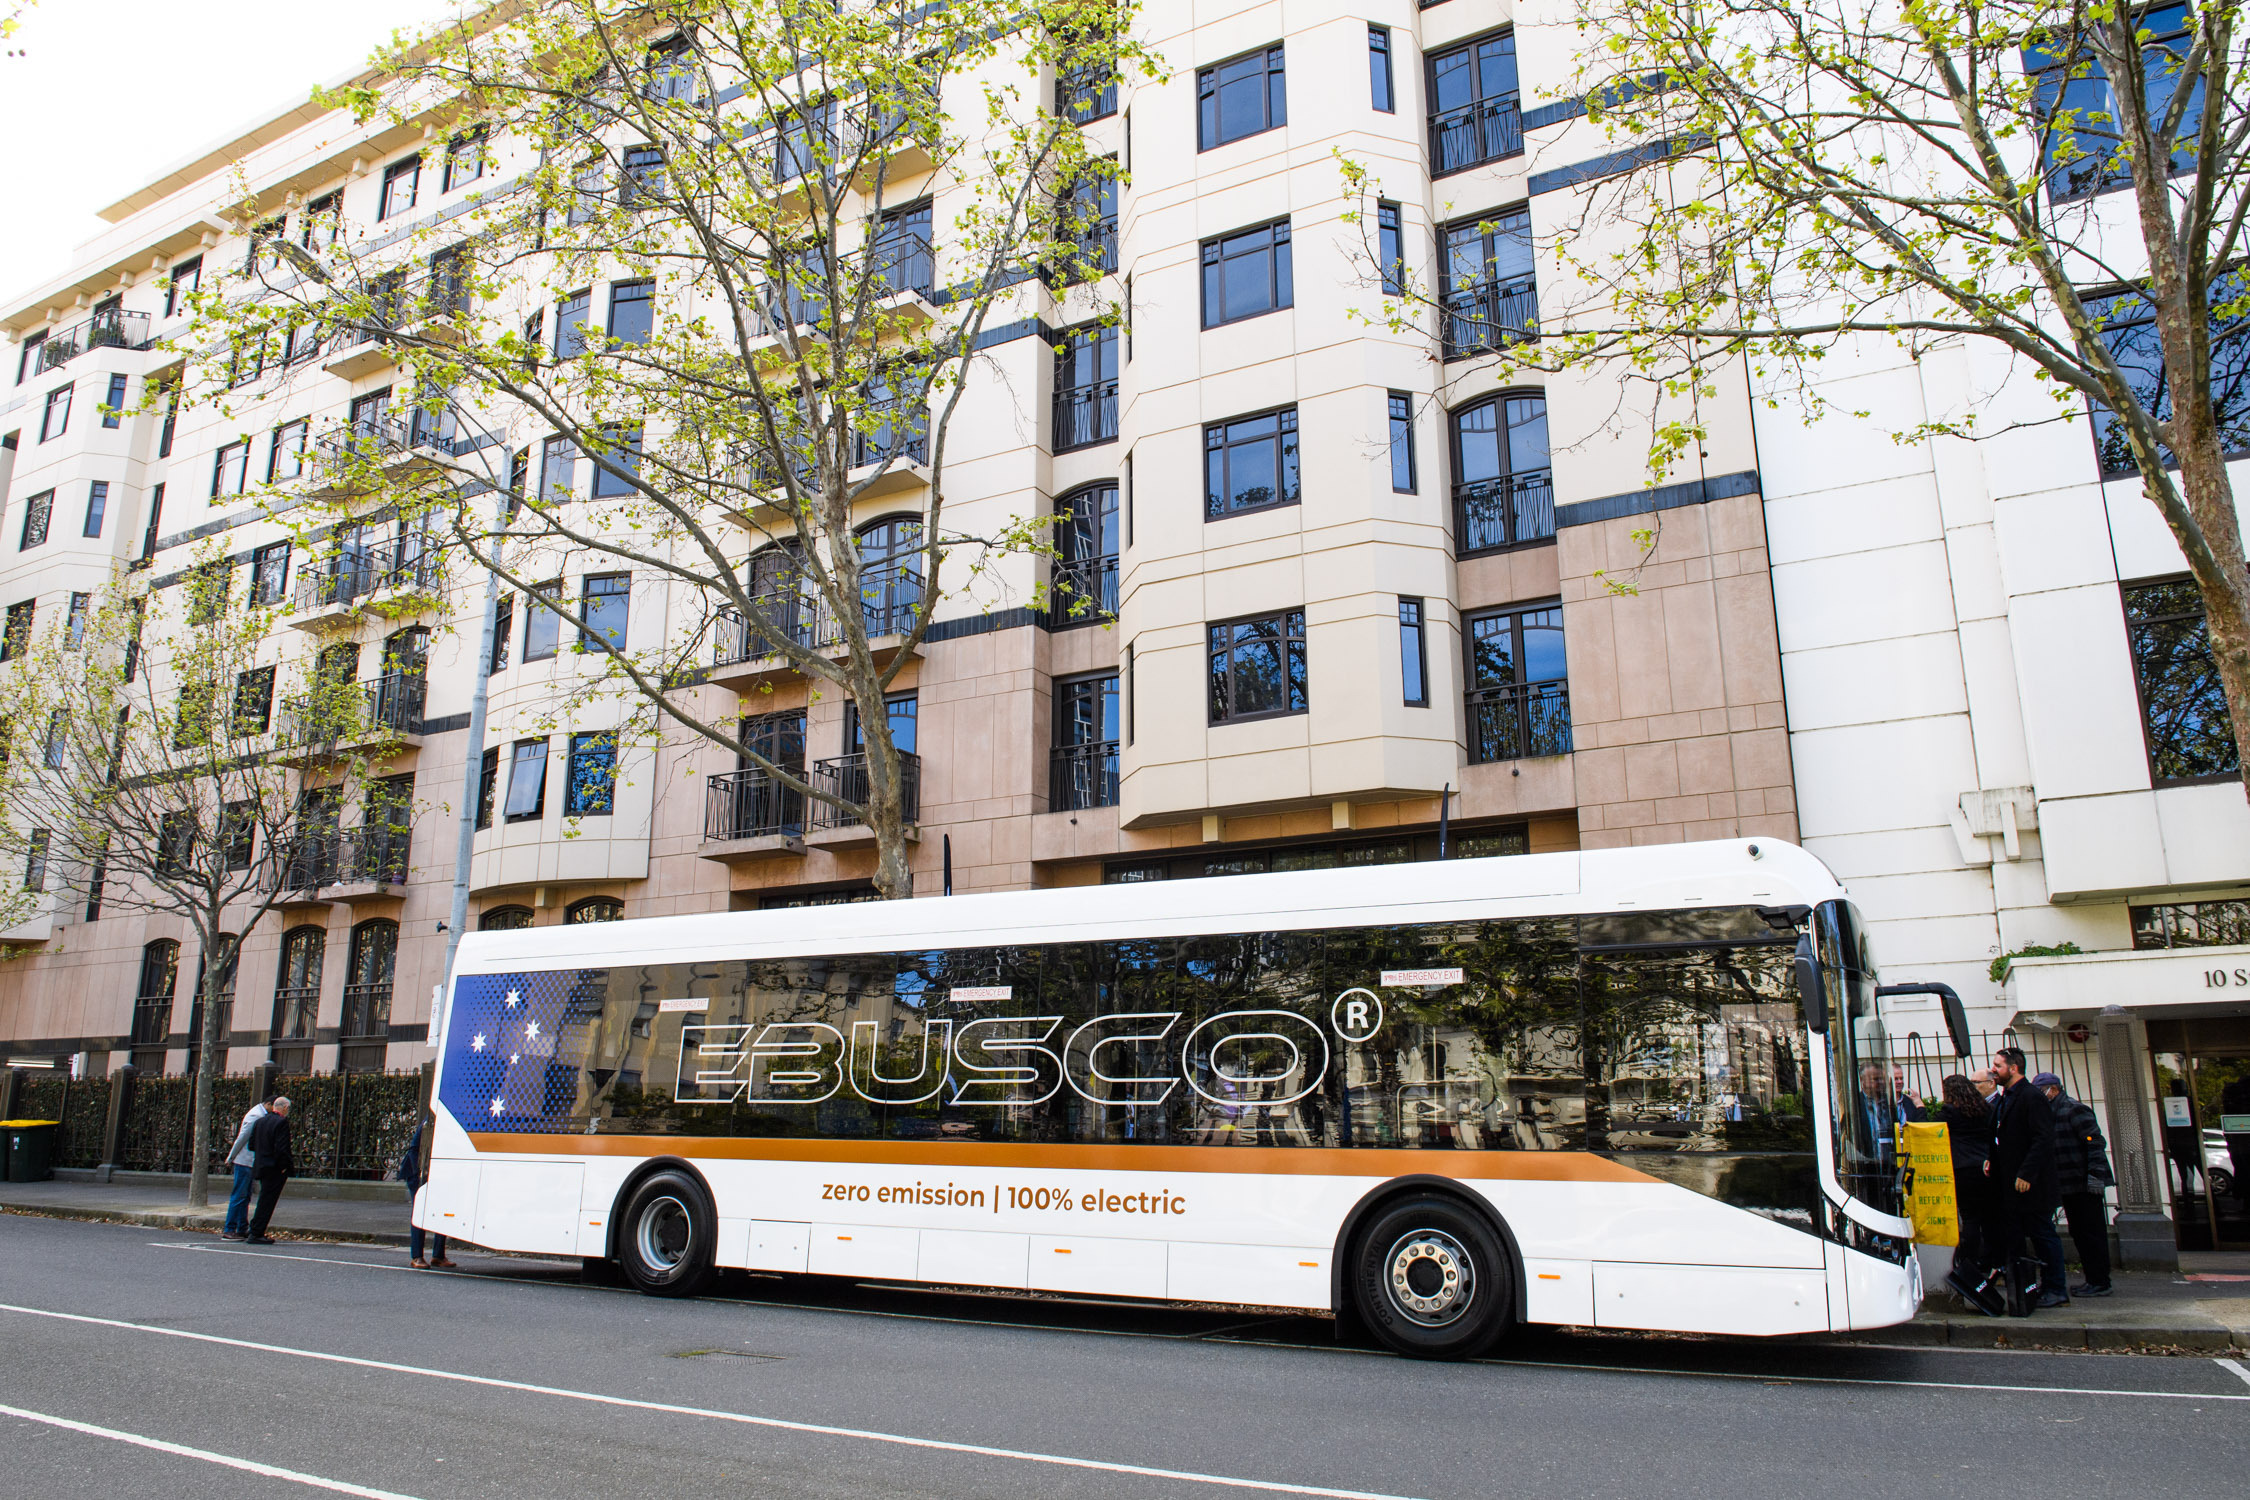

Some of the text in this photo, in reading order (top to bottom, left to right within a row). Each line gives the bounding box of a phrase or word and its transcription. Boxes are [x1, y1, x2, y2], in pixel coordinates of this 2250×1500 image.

[1398, 970, 1460, 982] EMERGENCY EXIT
[2203, 968, 2250, 988] 10 S
[963, 987, 1010, 998] EMERGENCY EXIT
[1913, 1154, 1949, 1164] RESERVED
[1918, 1175, 1949, 1184] PARKING
[821, 1183, 871, 1202] zero
[877, 1180, 986, 1208] emission
[1007, 1186, 1073, 1211] 100%
[1081, 1188, 1186, 1215] electric
[1919, 1195, 1952, 1205] REFER TO
[1926, 1216, 1947, 1225] SIGNS
